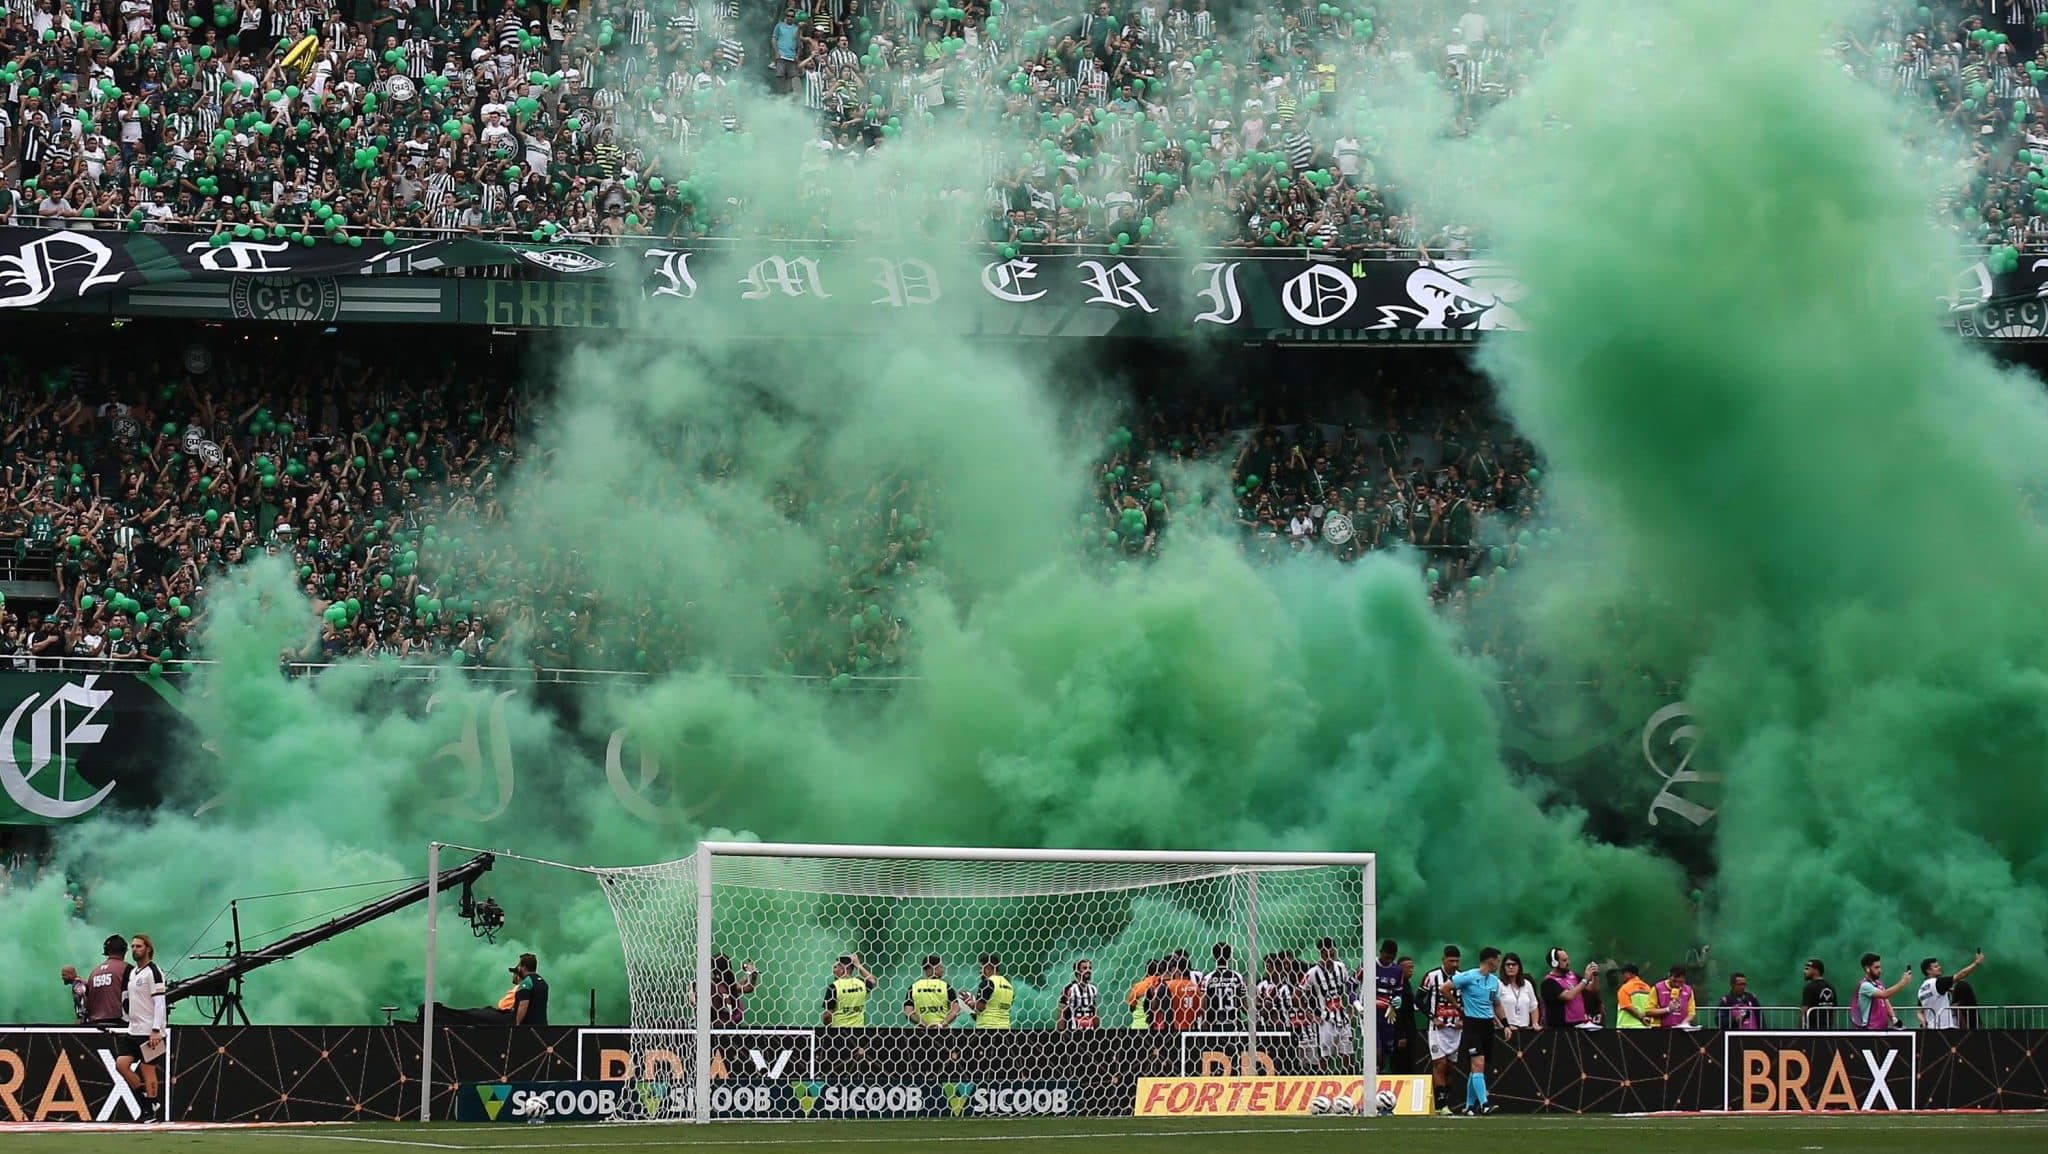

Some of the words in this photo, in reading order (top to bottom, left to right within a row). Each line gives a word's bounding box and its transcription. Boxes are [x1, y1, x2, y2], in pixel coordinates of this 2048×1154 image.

[256, 283, 314, 311] CFC
[93, 974, 113, 987] 1595
[1743, 1049, 1898, 1110] BRAX
[512, 1089, 616, 1116] SCOOB
[824, 1087, 923, 1111] SICOOB
[974, 1088, 1068, 1113] SICOOB
